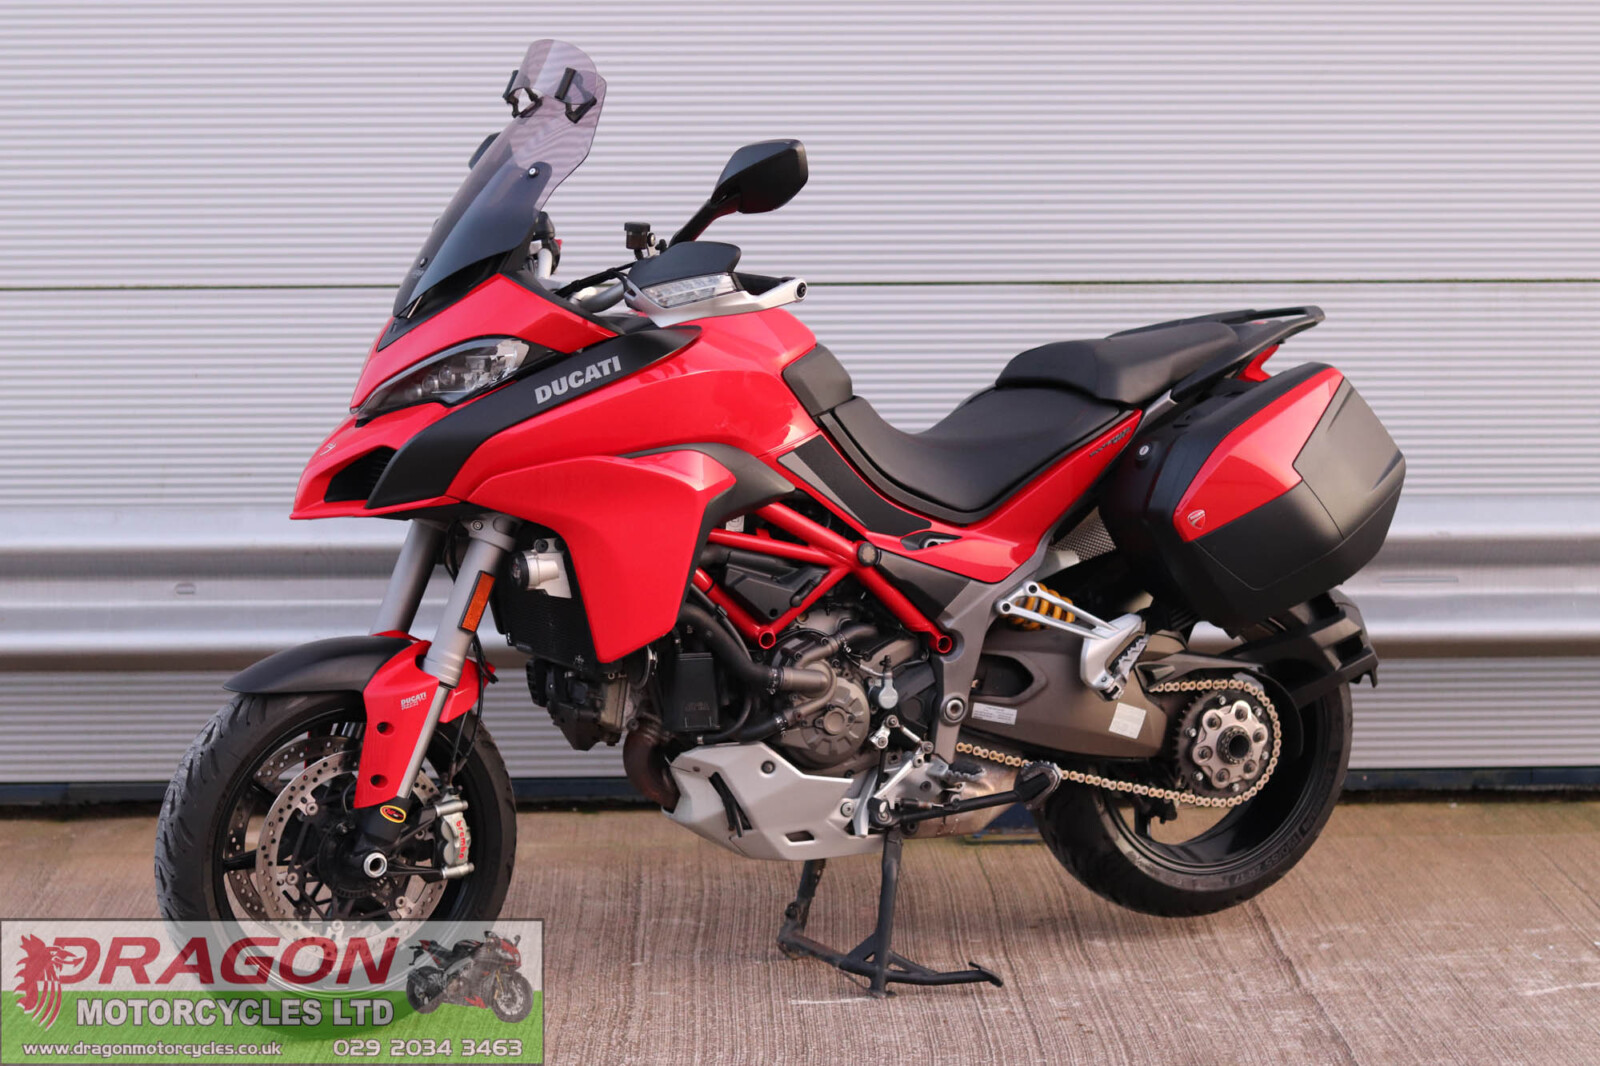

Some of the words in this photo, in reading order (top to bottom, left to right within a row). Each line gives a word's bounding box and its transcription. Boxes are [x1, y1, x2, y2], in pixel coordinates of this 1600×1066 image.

[534, 355, 622, 404] DUCATI
[400, 691, 427, 706] DUCATI
[456, 820, 468, 859] brembo
